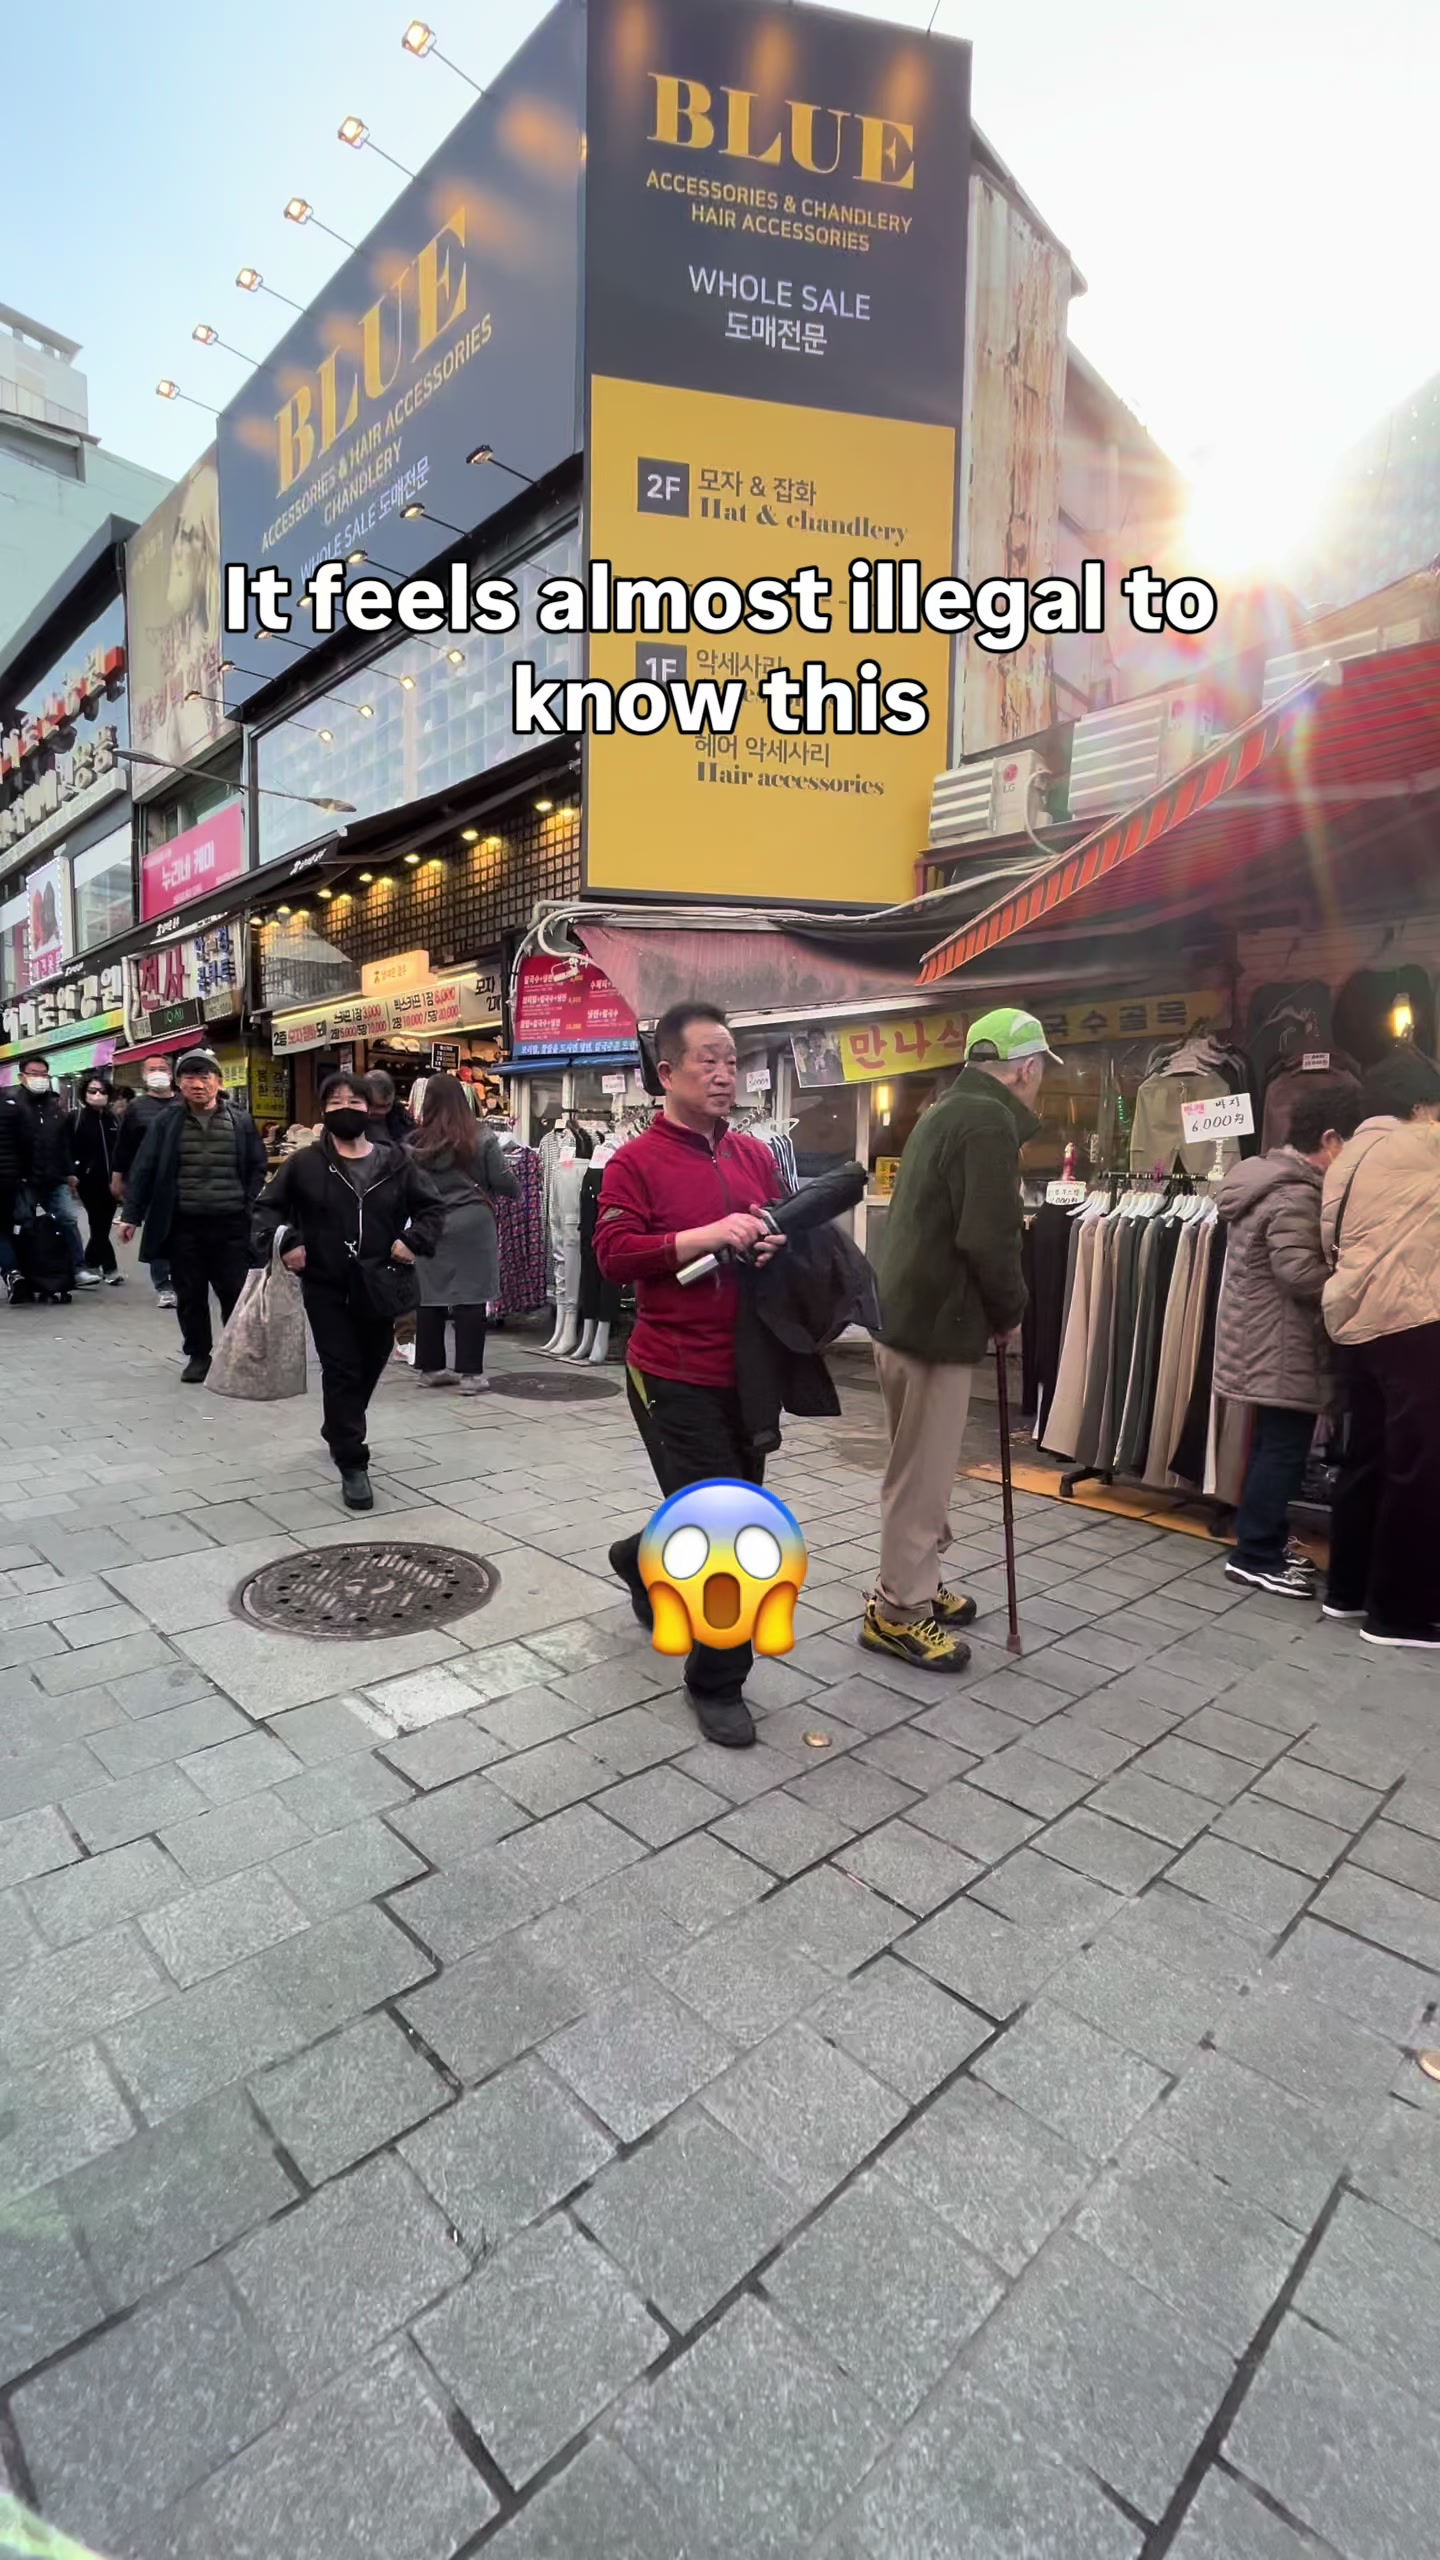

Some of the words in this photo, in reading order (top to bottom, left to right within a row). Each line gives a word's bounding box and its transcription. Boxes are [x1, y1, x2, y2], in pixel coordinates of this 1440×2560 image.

[646, 72, 915, 190] BLUE
[646, 170, 778, 211] ACCESSORIES
[783, 195, 797, 214] &
[801, 199, 913, 234] CHANDLERY
[691, 205, 737, 230] HAIR
[742, 216, 870, 252] ACCESSORIES
[689, 265, 793, 308] WHOLE
[801, 284, 871, 321] SALE
[274, 207, 467, 499] BLUE
[725, 312, 828, 356] 도매전문
[261, 466, 337, 554] ACCESSORIES
[338, 458, 349, 478] &
[349, 422, 382, 468] HAIR
[384, 313, 493, 434] ACCESSORIES
[324, 436, 403, 527] CHANDLERY
[647, 474, 681, 501] 2F
[698, 468, 743, 497] 모자
[750, 477, 766, 497] &
[773, 477, 817, 506] 잡화
[300, 531, 342, 586] WHOLE
[344, 503, 377, 548] SALE
[379, 455, 430, 519] 도매전문
[699, 496, 747, 523] Hat
[756, 505, 779, 526] &
[786, 511, 908, 547] chandlery
[645, 656, 678, 683] 1F
[696, 648, 783, 680] 악세사리
[695, 734, 738, 760] 헤어
[745, 736, 830, 768] 악세사리
[697, 761, 754, 786] Hair
[757, 765, 885, 796] accessories
[1003, 783, 1016, 793] LG
[474, 975, 496, 996] 모자
[1043, 999, 1187, 1037] 국수골목
[848, 1011, 969, 1071] 만나식
[1215, 1096, 1240, 1110] 바지
